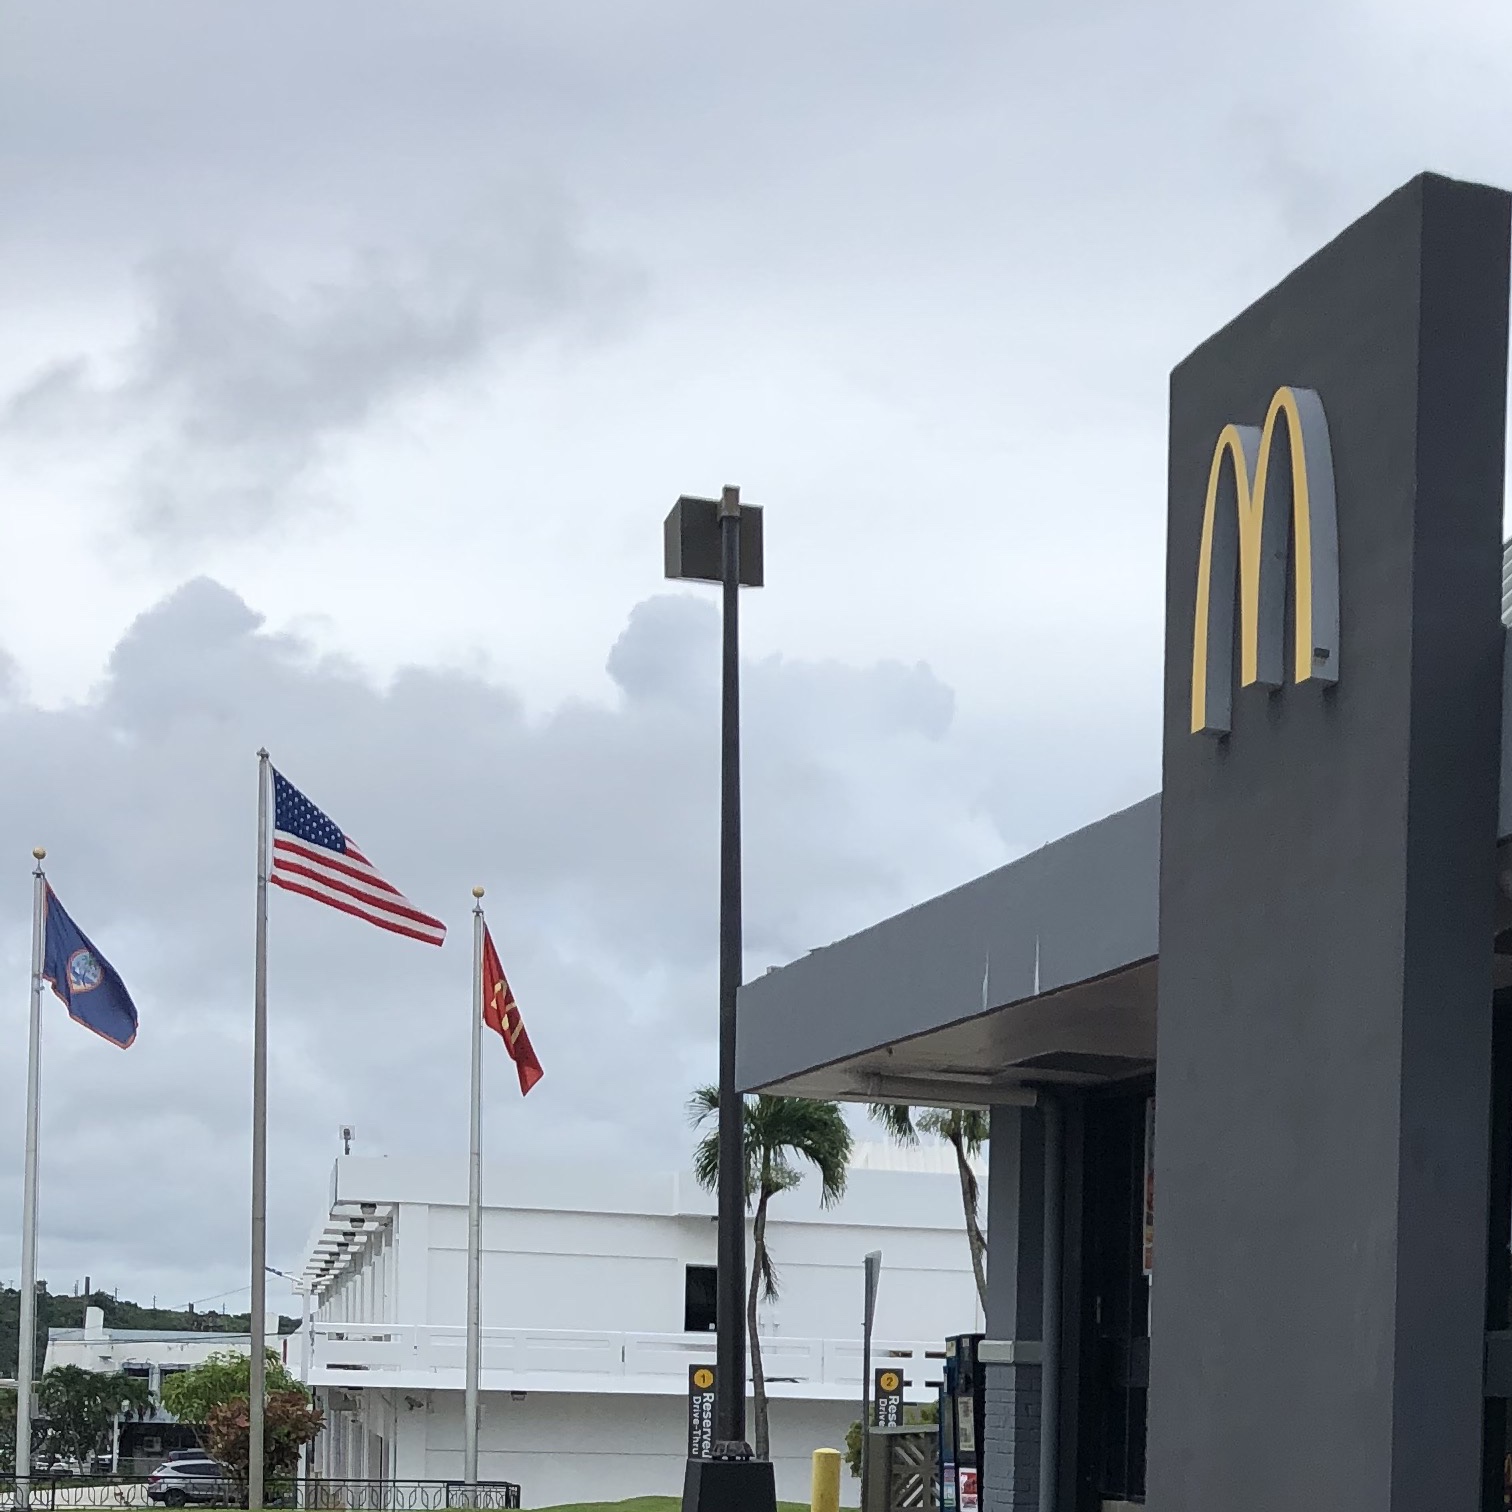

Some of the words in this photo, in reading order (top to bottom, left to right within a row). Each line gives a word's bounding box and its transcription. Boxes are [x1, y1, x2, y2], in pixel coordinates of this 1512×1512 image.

[1191, 386, 1325, 735] M
[692, 1395, 702, 1455] Drive-Thru
[888, 1395, 900, 1428] Rese
